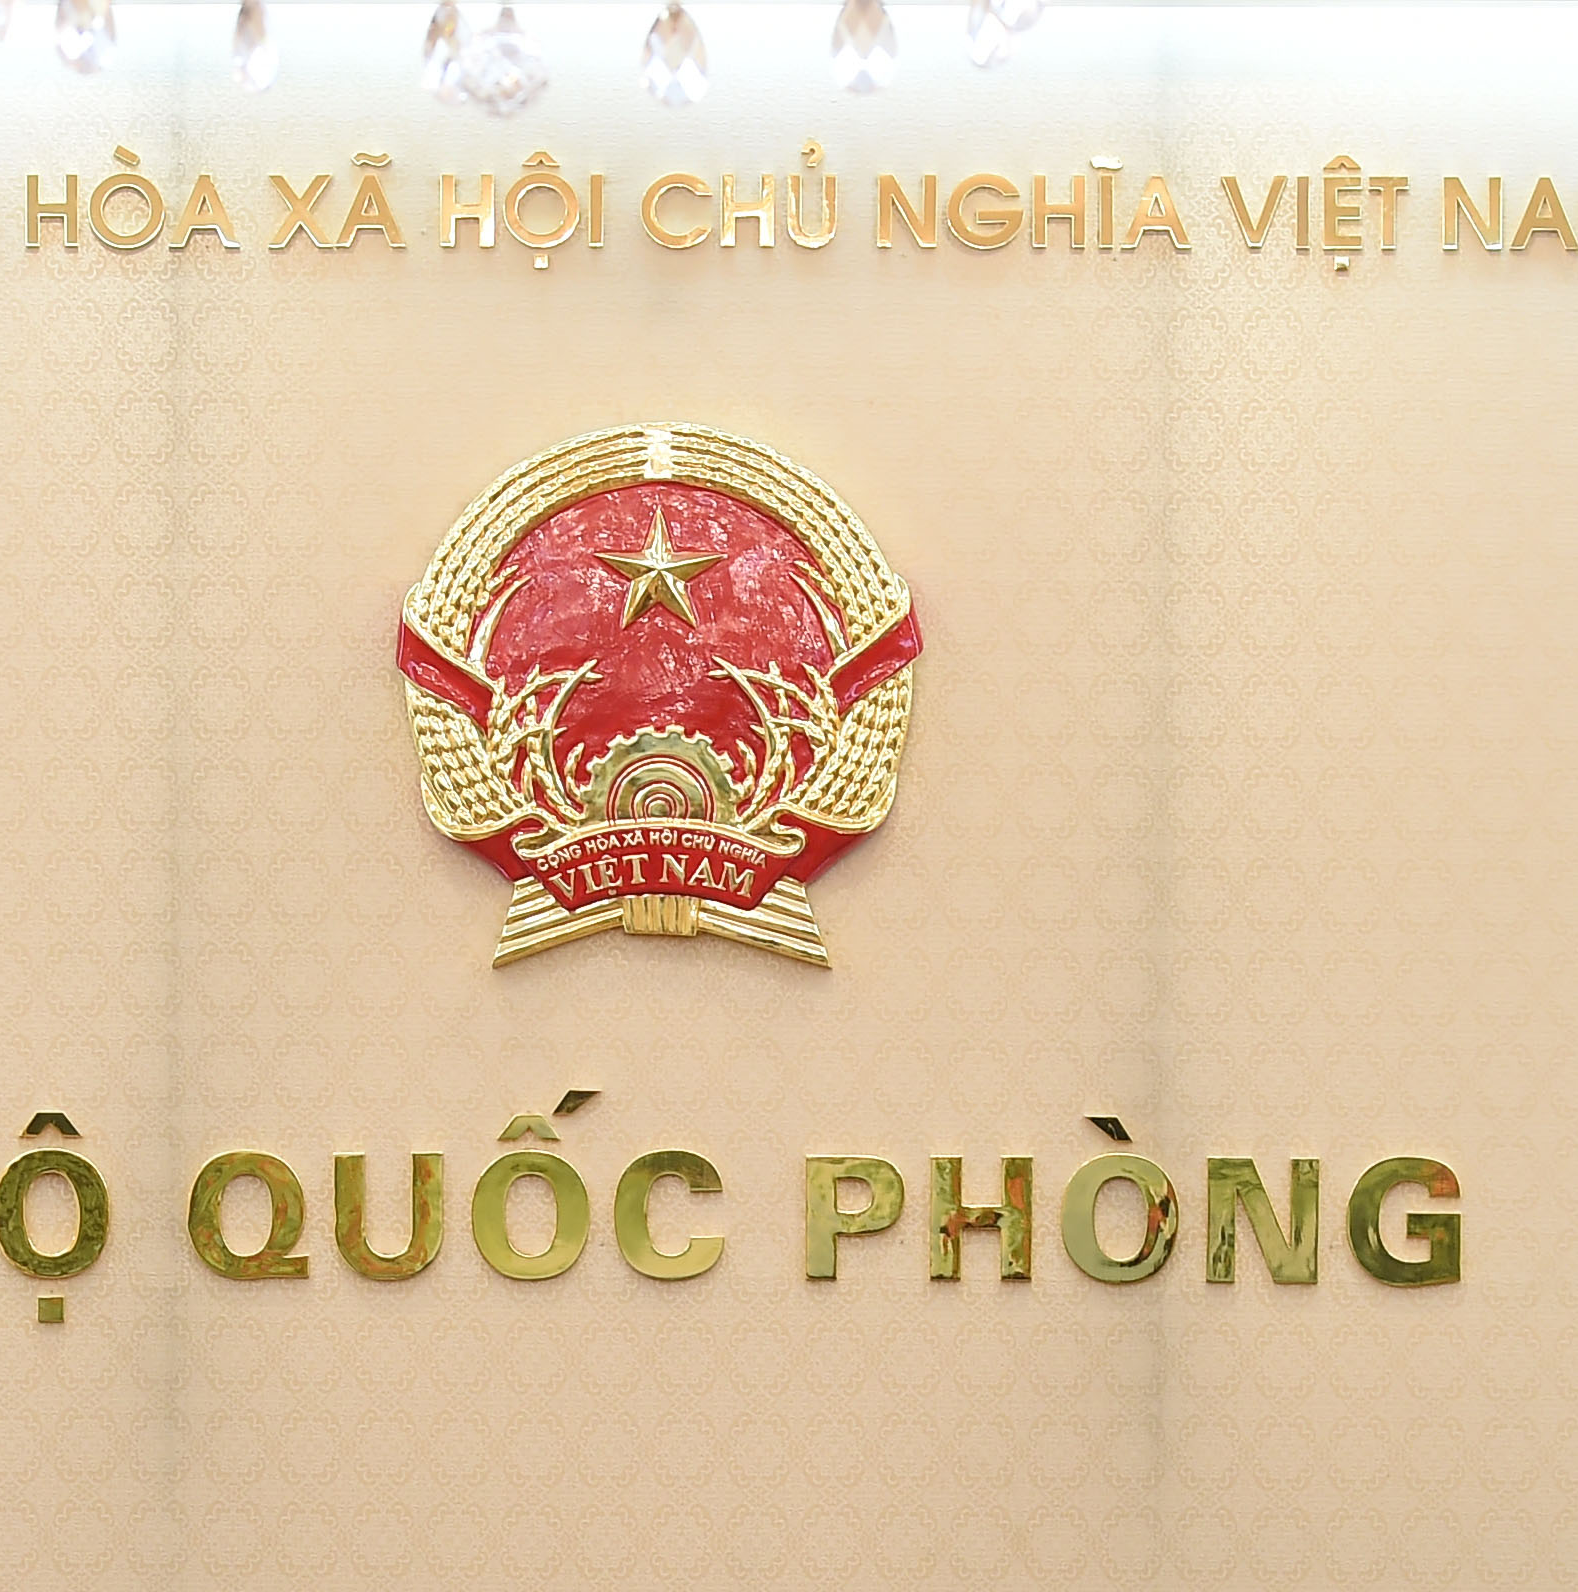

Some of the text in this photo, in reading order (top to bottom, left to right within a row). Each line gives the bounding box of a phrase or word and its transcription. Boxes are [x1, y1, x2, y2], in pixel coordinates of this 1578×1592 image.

[24, 144, 240, 250] HÒA
[267, 152, 407, 250] XÃ
[438, 151, 605, 270] HỘI
[640, 141, 837, 250] CHỦ
[874, 155, 1192, 252] NGHĨA
[1220, 155, 1410, 271] VIỆT
[548, 853, 755, 900] VIỆT NAM
[583, 833, 621, 855] HÒA
[622, 829, 646, 847] XÃ
[187, 1089, 726, 1282] QUỐC
[804, 1115, 1464, 1288] PHÒNG
